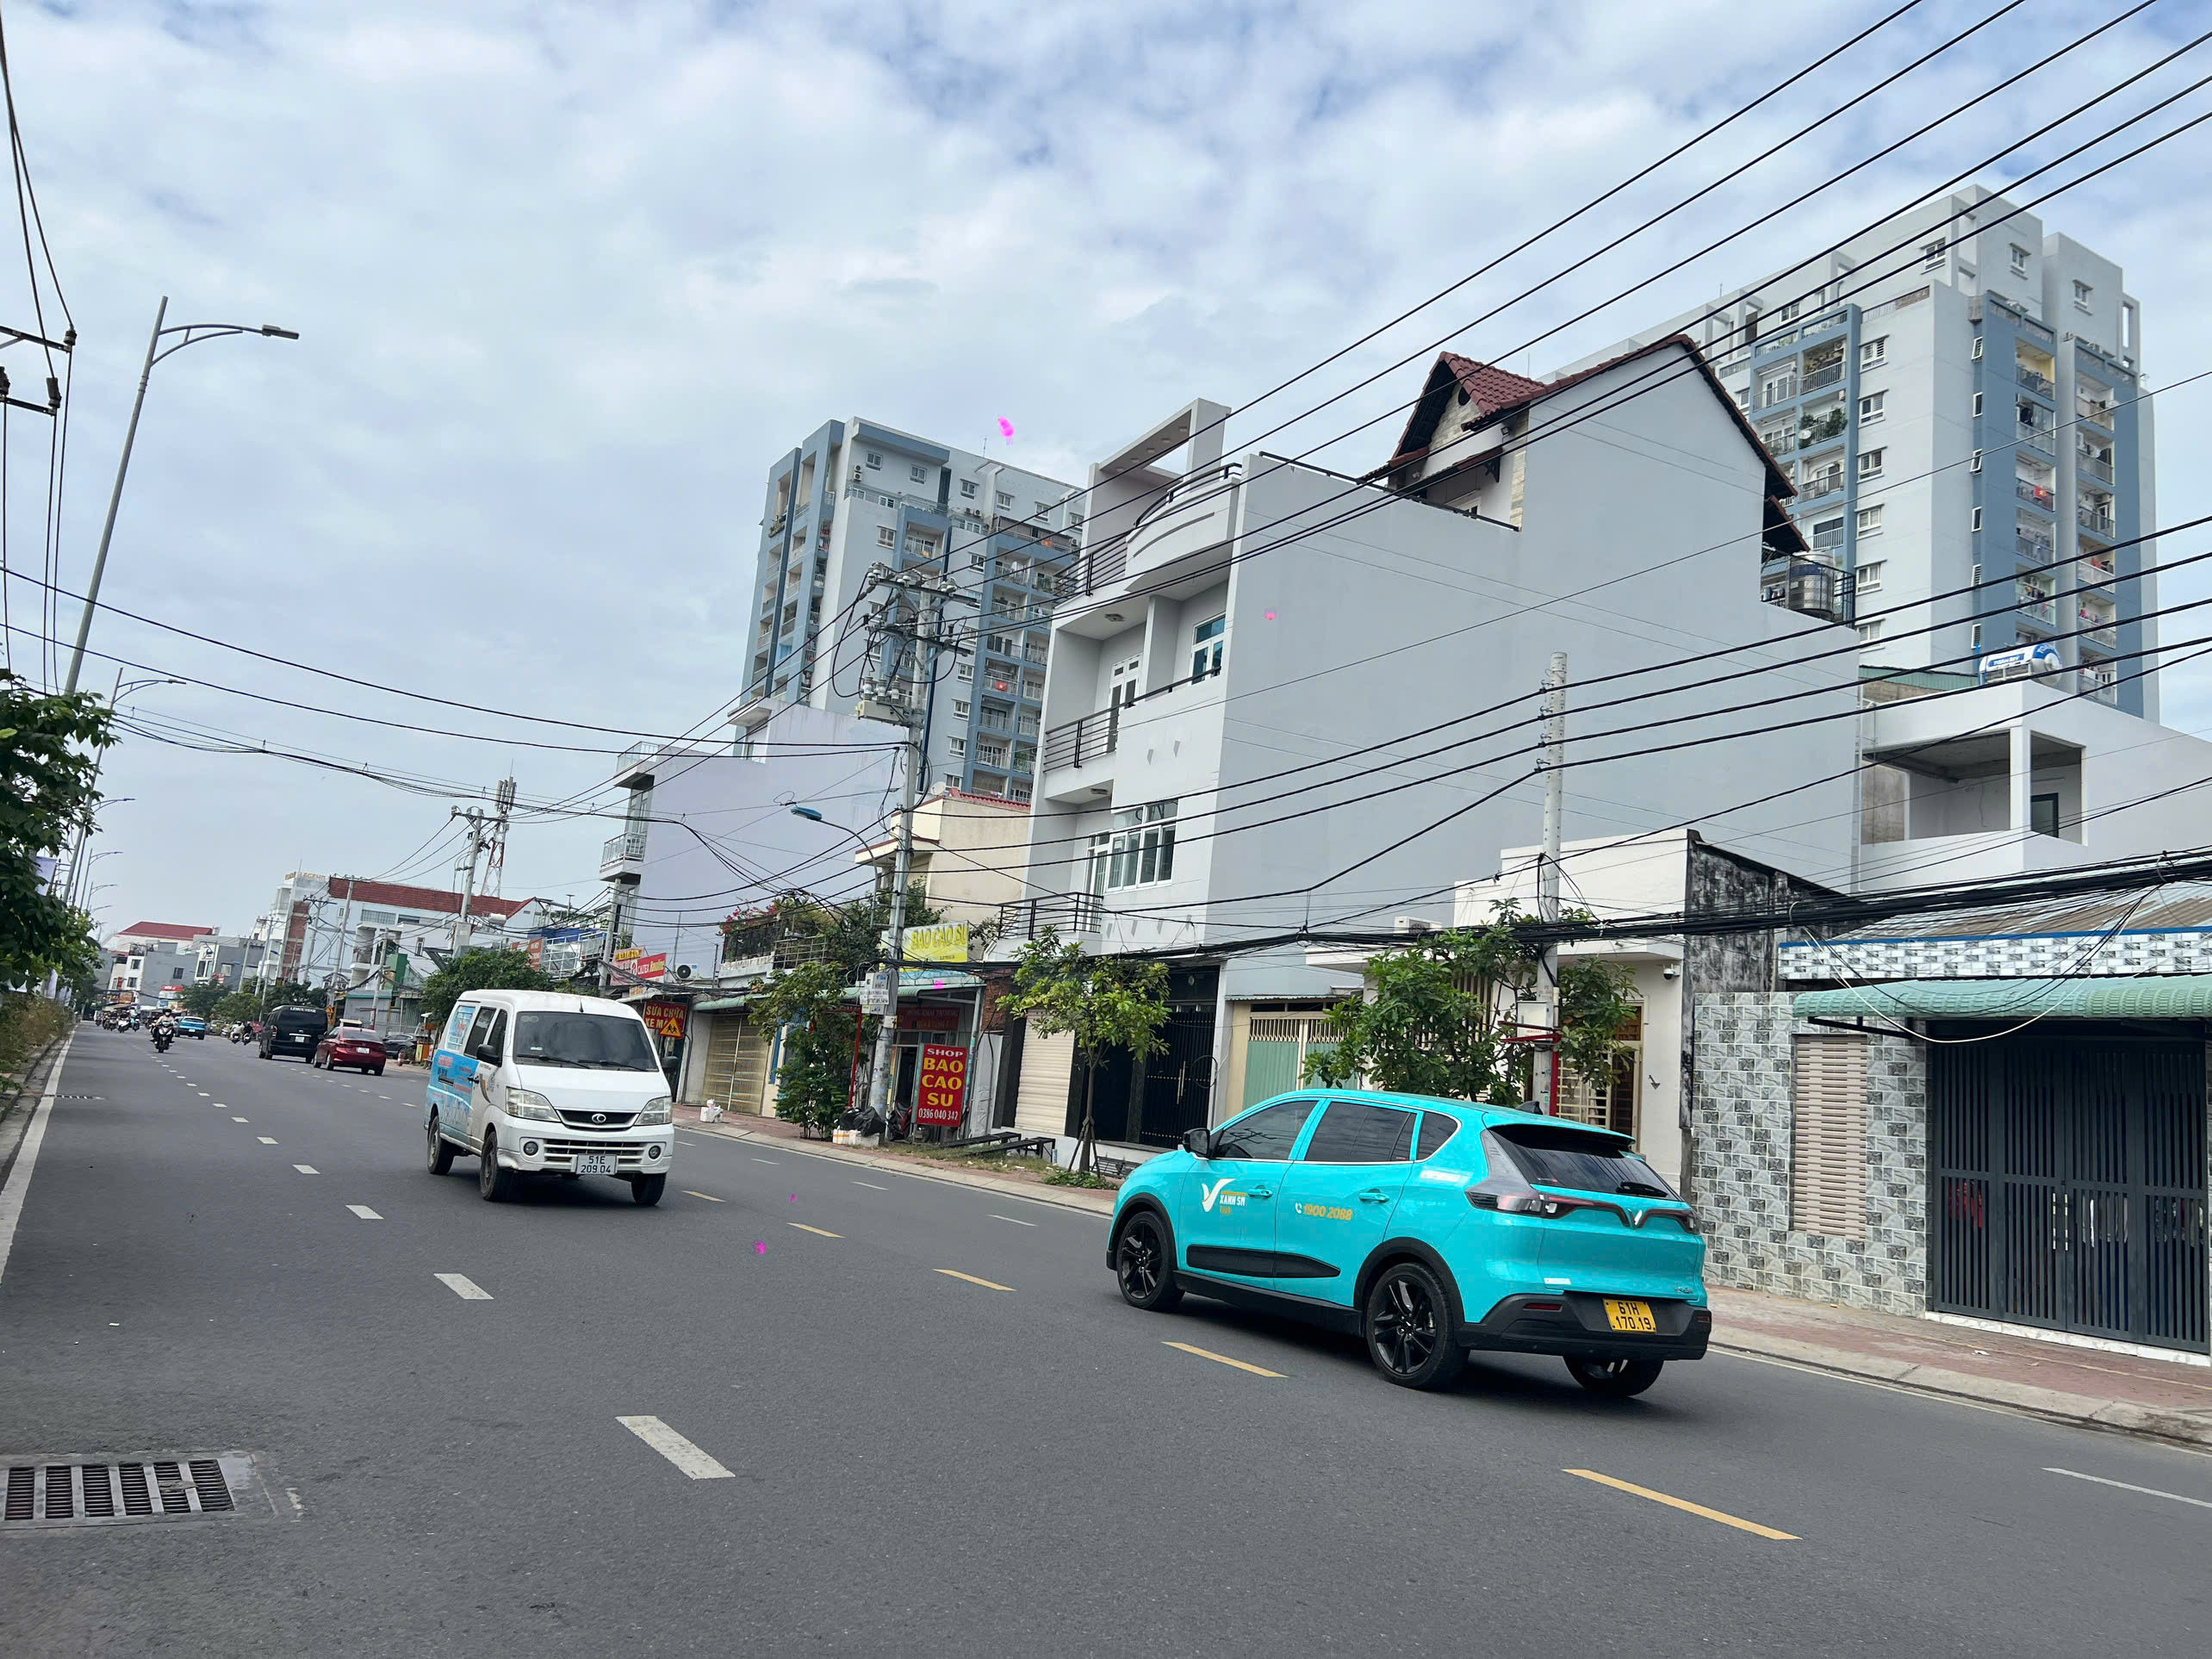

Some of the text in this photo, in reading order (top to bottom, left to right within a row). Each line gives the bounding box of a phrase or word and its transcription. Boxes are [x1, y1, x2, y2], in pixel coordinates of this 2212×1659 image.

[911, 923, 966, 948] BAO CAO SU
[645, 1017, 655, 1028] XE
[927, 1048, 963, 1057] SHOP
[923, 1057, 963, 1073] BAO
[922, 1074, 962, 1090] CAO
[927, 1092, 954, 1107] SU
[918, 1108, 934, 1119] 0386
[934, 1109, 947, 1120] 040
[588, 1155, 606, 1164] 51E
[1220, 1194, 1246, 1207] XANH SM
[1302, 1203, 1353, 1221] 1900 2088
[1619, 1302, 1640, 1315] 61H
[1615, 1315, 1651, 1330] 170.19
